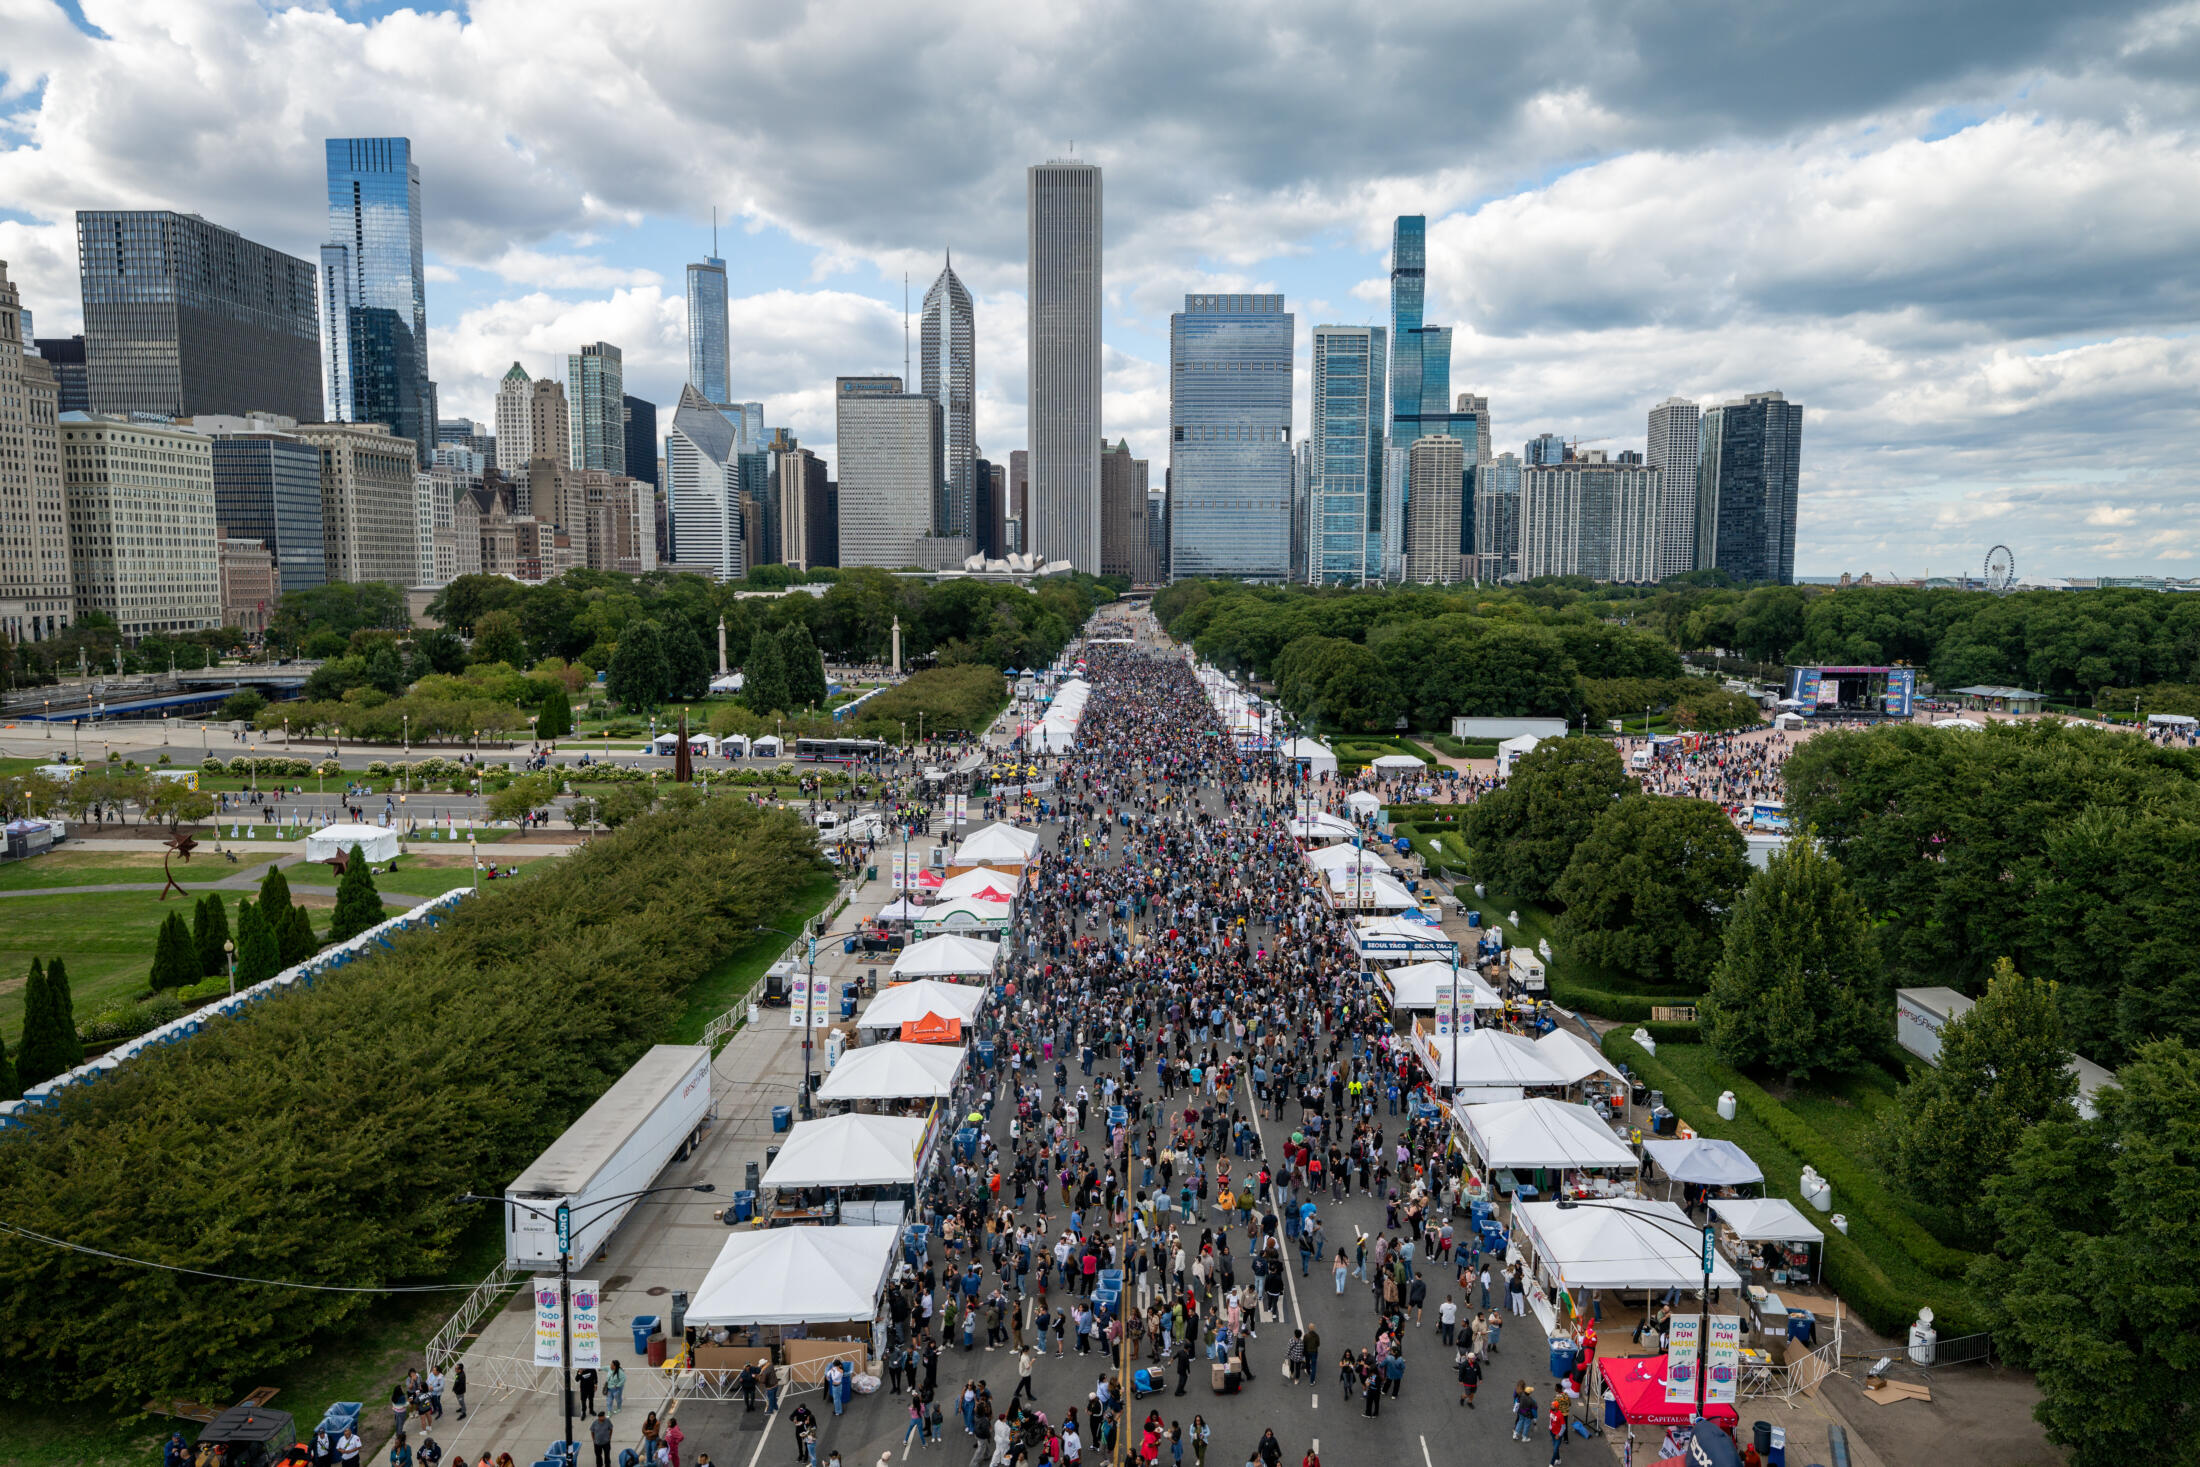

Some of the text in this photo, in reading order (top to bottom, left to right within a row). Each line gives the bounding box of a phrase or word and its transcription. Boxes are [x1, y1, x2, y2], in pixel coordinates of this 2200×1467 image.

[133, 411, 176, 423] MOTOROLA
[559, 1213, 568, 1249] C540
[1705, 1233, 1714, 1269] C541
[541, 1321, 556, 1329] FUN
[537, 1330, 560, 1338] MUSIC
[541, 1339, 556, 1347] ART
[1710, 1341, 1739, 1349] MUSIC
